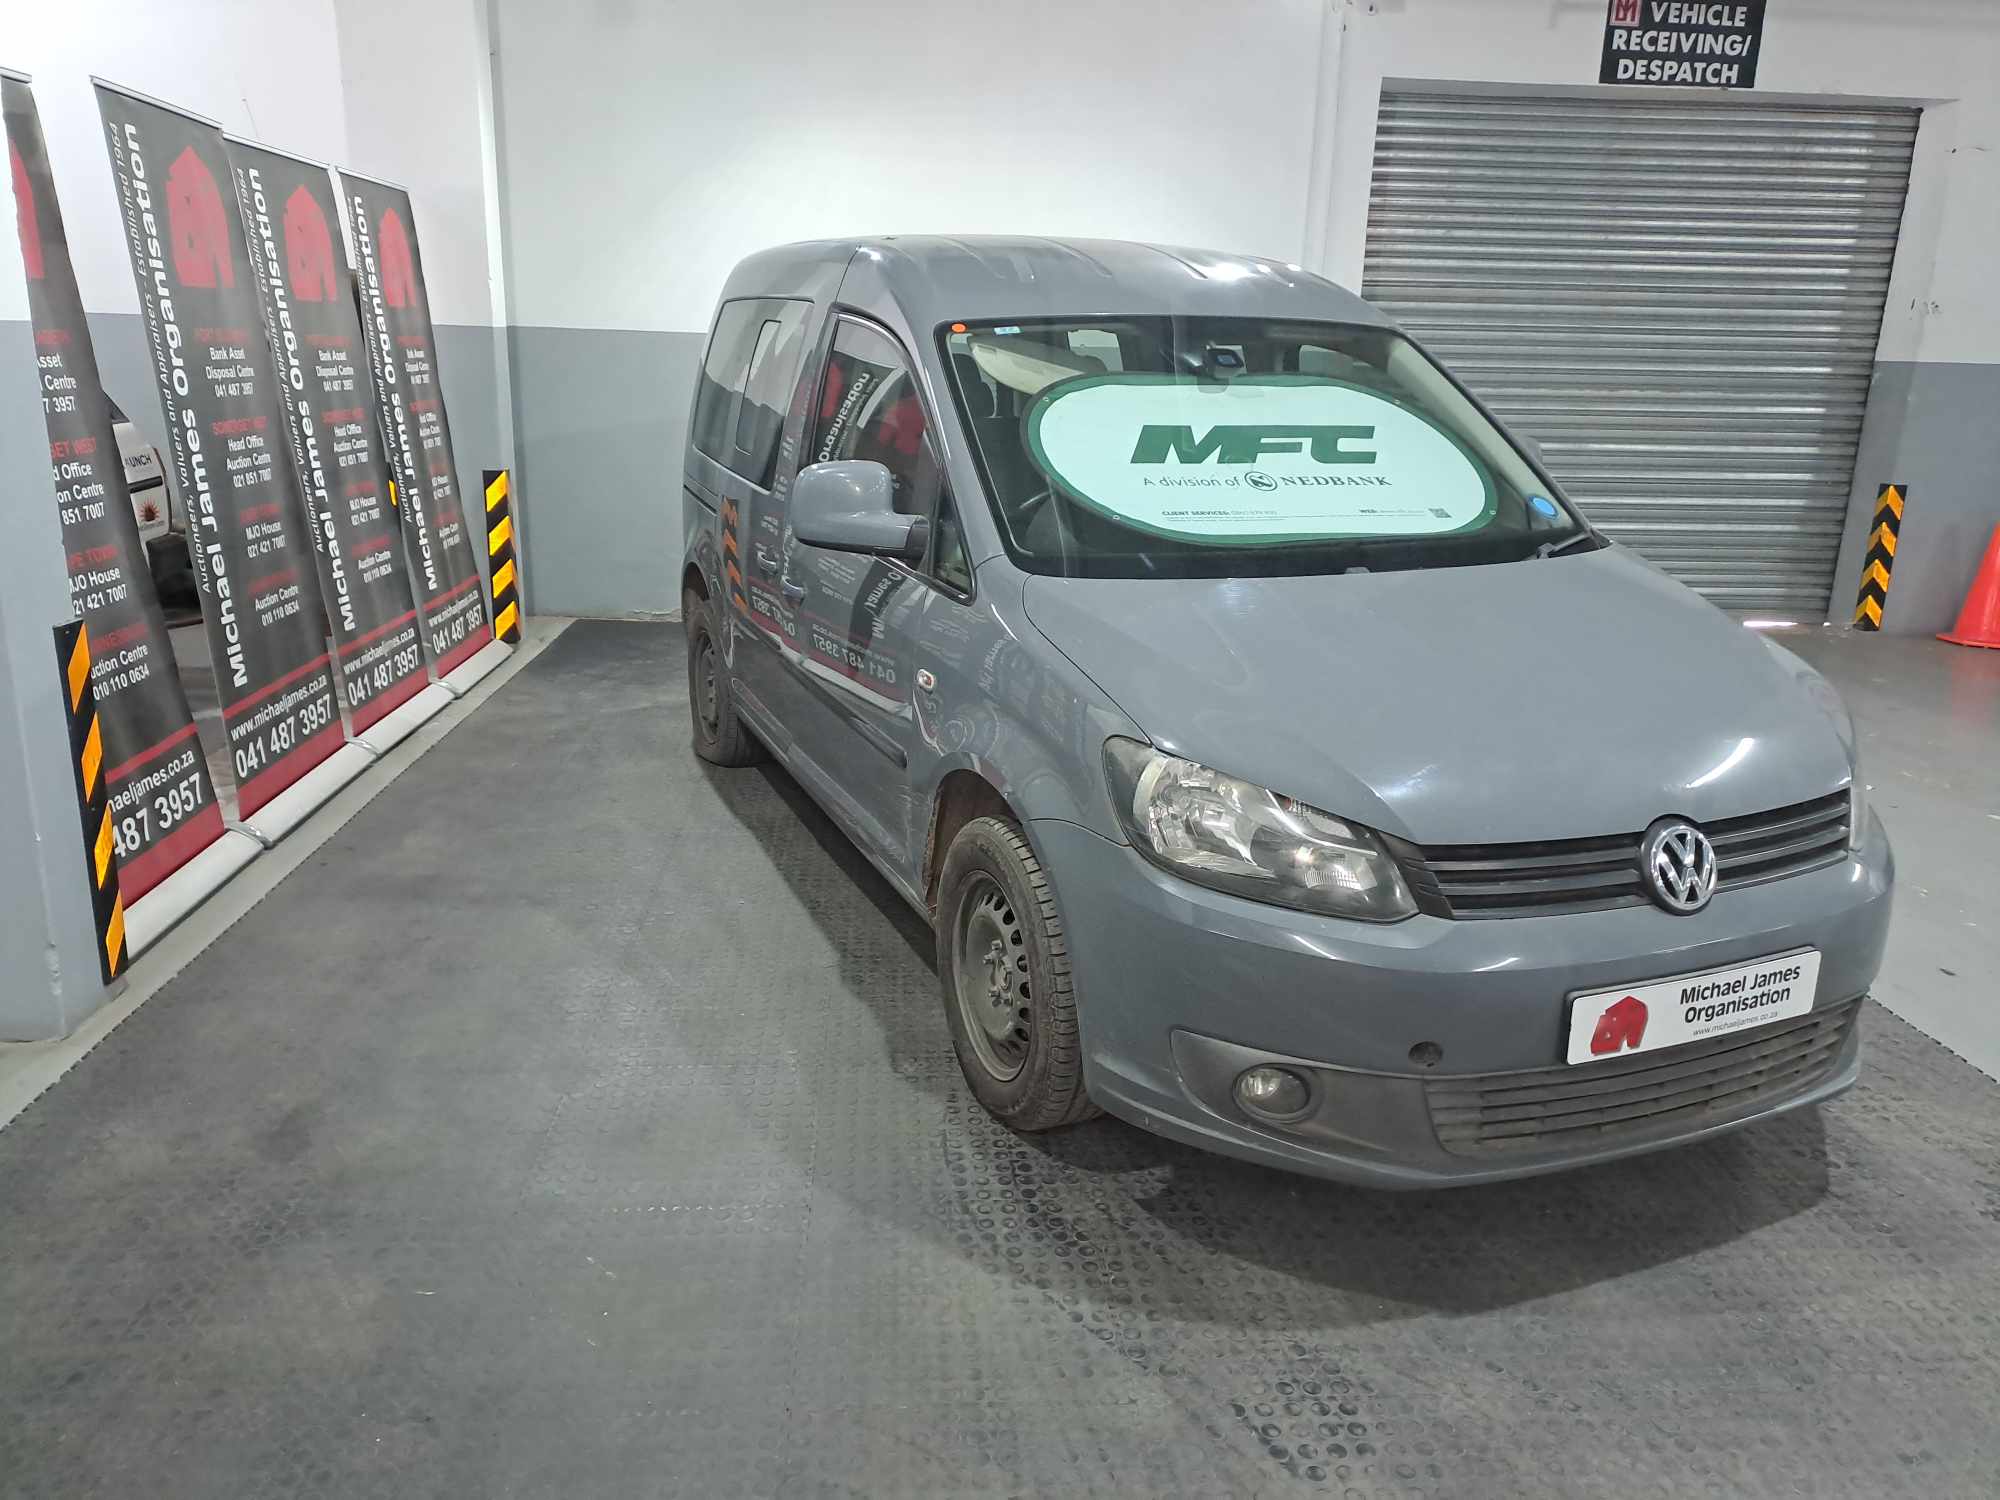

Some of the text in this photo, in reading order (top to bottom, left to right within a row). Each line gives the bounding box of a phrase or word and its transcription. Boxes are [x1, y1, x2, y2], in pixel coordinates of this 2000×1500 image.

[1651, 2, 1748, 27] VEHICLE
[1611, 29, 1752, 57] RECEIVING/
[1616, 58, 1739, 85] DESPATCH
[109, 122, 127, 167] 1964
[120, 170, 146, 276] Established
[354, 196, 396, 385] Organisation
[145, 292, 170, 386] Appraisers
[44, 374, 77, 391] Centre
[249, 168, 356, 632] Michael James Organisation
[52, 395, 75, 413] 3957
[124, 122, 248, 688] Michael James Organisation
[163, 389, 176, 423] and
[391, 393, 416, 481] James
[1130, 424, 1377, 464] MFC
[61, 462, 93, 480] Office
[1159, 475, 1221, 488] division
[1224, 476, 1241, 488] of
[1280, 475, 1393, 487] NEDBANK
[72, 482, 105, 499] Centre
[62, 502, 105, 525] 851 7007
[408, 488, 439, 591] Michael
[88, 567, 121, 586] House
[87, 592, 105, 609] 421
[106, 583, 128, 602] 7007
[254, 592, 279, 612] Auction
[432, 603, 483, 655] 041 487 3957
[119, 643, 149, 666] Centre
[110, 674, 128, 693] 110
[130, 663, 150, 686] 0634
[348, 643, 420, 707] 041 487 3957
[230, 674, 328, 742] www.michaeljames.co.za
[235, 693, 332, 779] 041 487 3957
[154, 771, 204, 830] 3957
[1680, 964, 1801, 1005] Michael James
[1684, 987, 1791, 1024] Organisation
[1692, 1010, 1778, 1037] www.michaeljames.co.za
